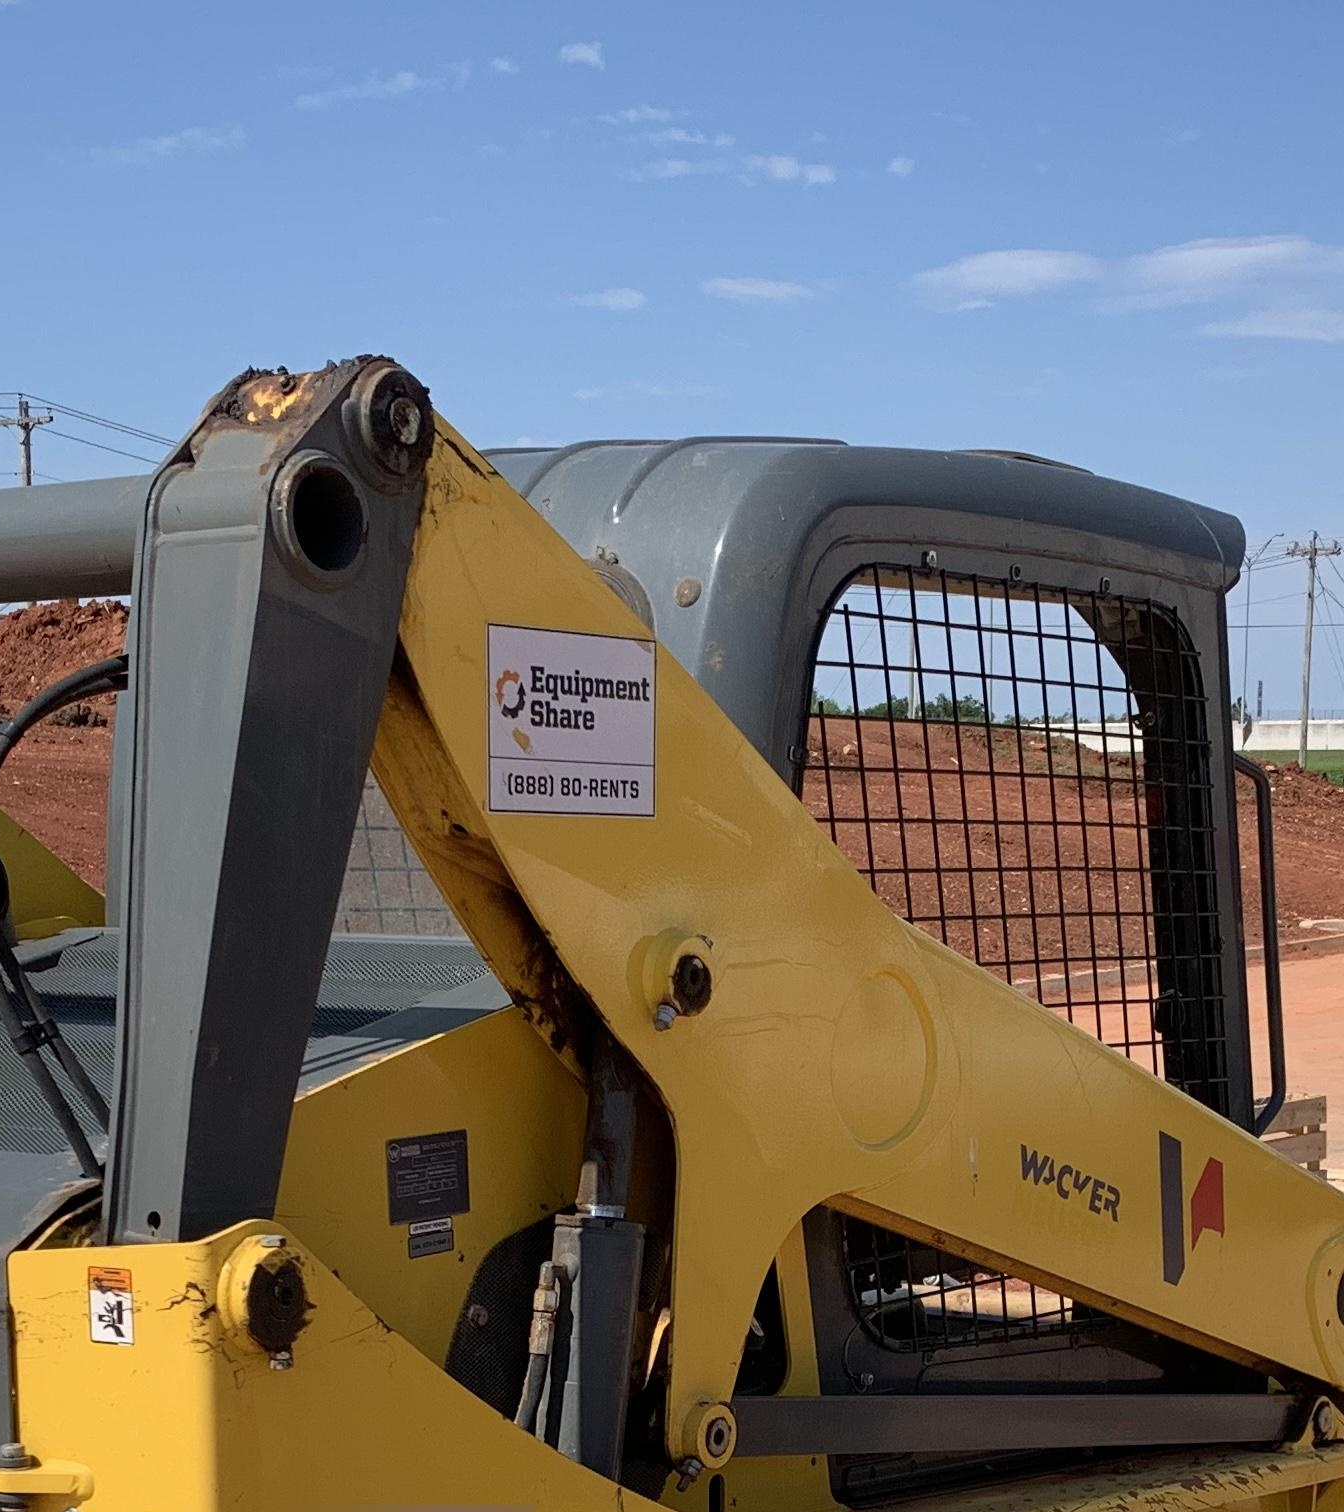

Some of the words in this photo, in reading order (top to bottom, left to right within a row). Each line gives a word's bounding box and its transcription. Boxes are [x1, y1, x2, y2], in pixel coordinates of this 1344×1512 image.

[530, 665, 650, 702] Equipment
[530, 700, 595, 730] Share
[507, 773, 555, 797] (888)
[560, 777, 640, 799] 80-RENTS
